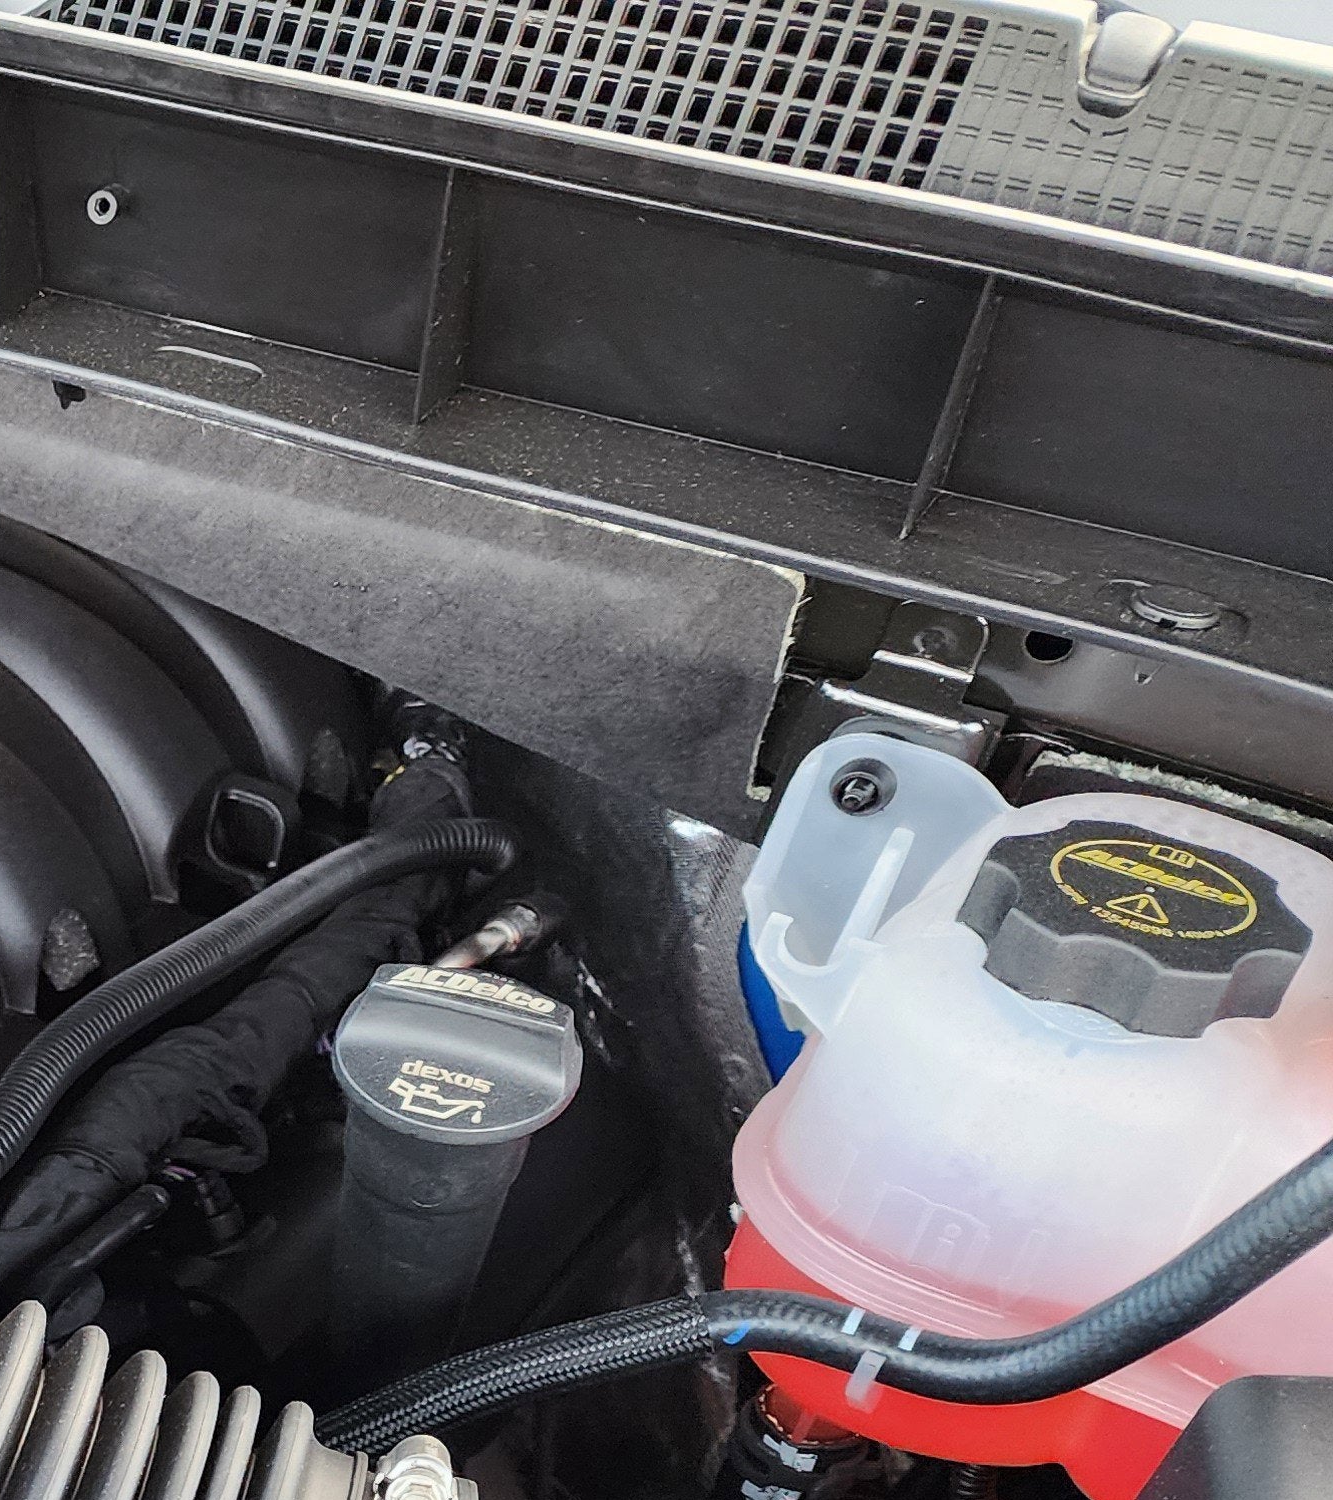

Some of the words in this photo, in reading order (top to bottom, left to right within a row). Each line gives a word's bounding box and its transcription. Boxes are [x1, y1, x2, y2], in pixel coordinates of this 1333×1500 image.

[1075, 850, 1249, 906] ACDelco
[391, 966, 557, 1014] ACDelco
[400, 1059, 496, 1094] dexos
